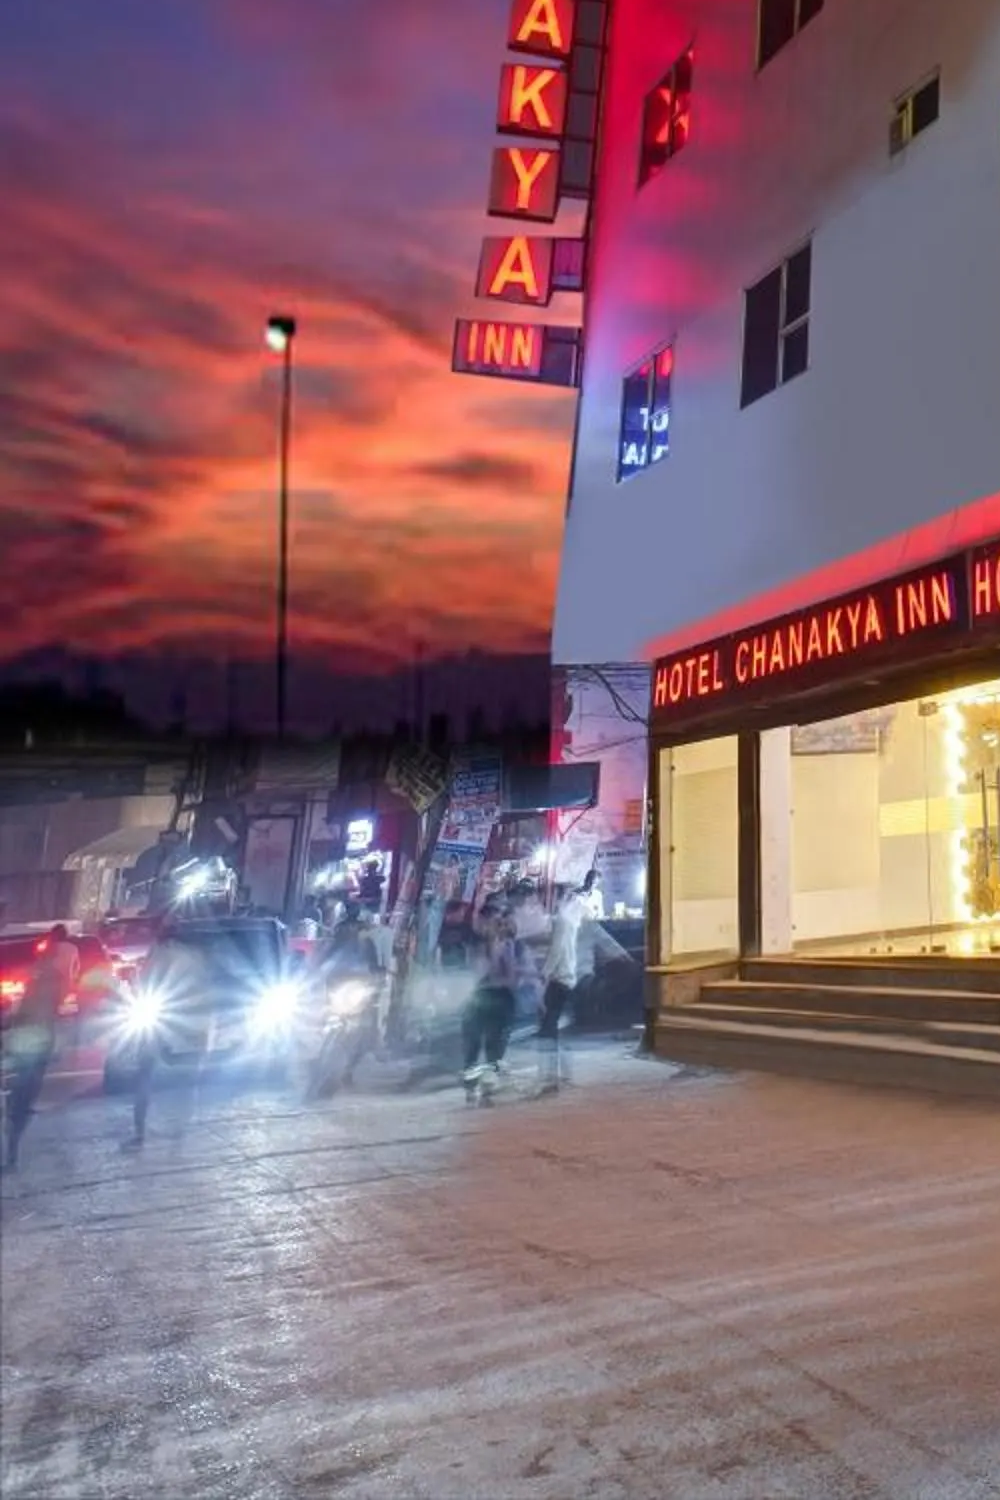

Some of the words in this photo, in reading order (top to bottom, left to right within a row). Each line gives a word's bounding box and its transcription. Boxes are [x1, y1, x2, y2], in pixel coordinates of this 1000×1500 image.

[468, 320, 535, 367] INN
[654, 649, 724, 708] HOTEL
[735, 595, 882, 684] CHANAKYA
[896, 571, 951, 636] INN
